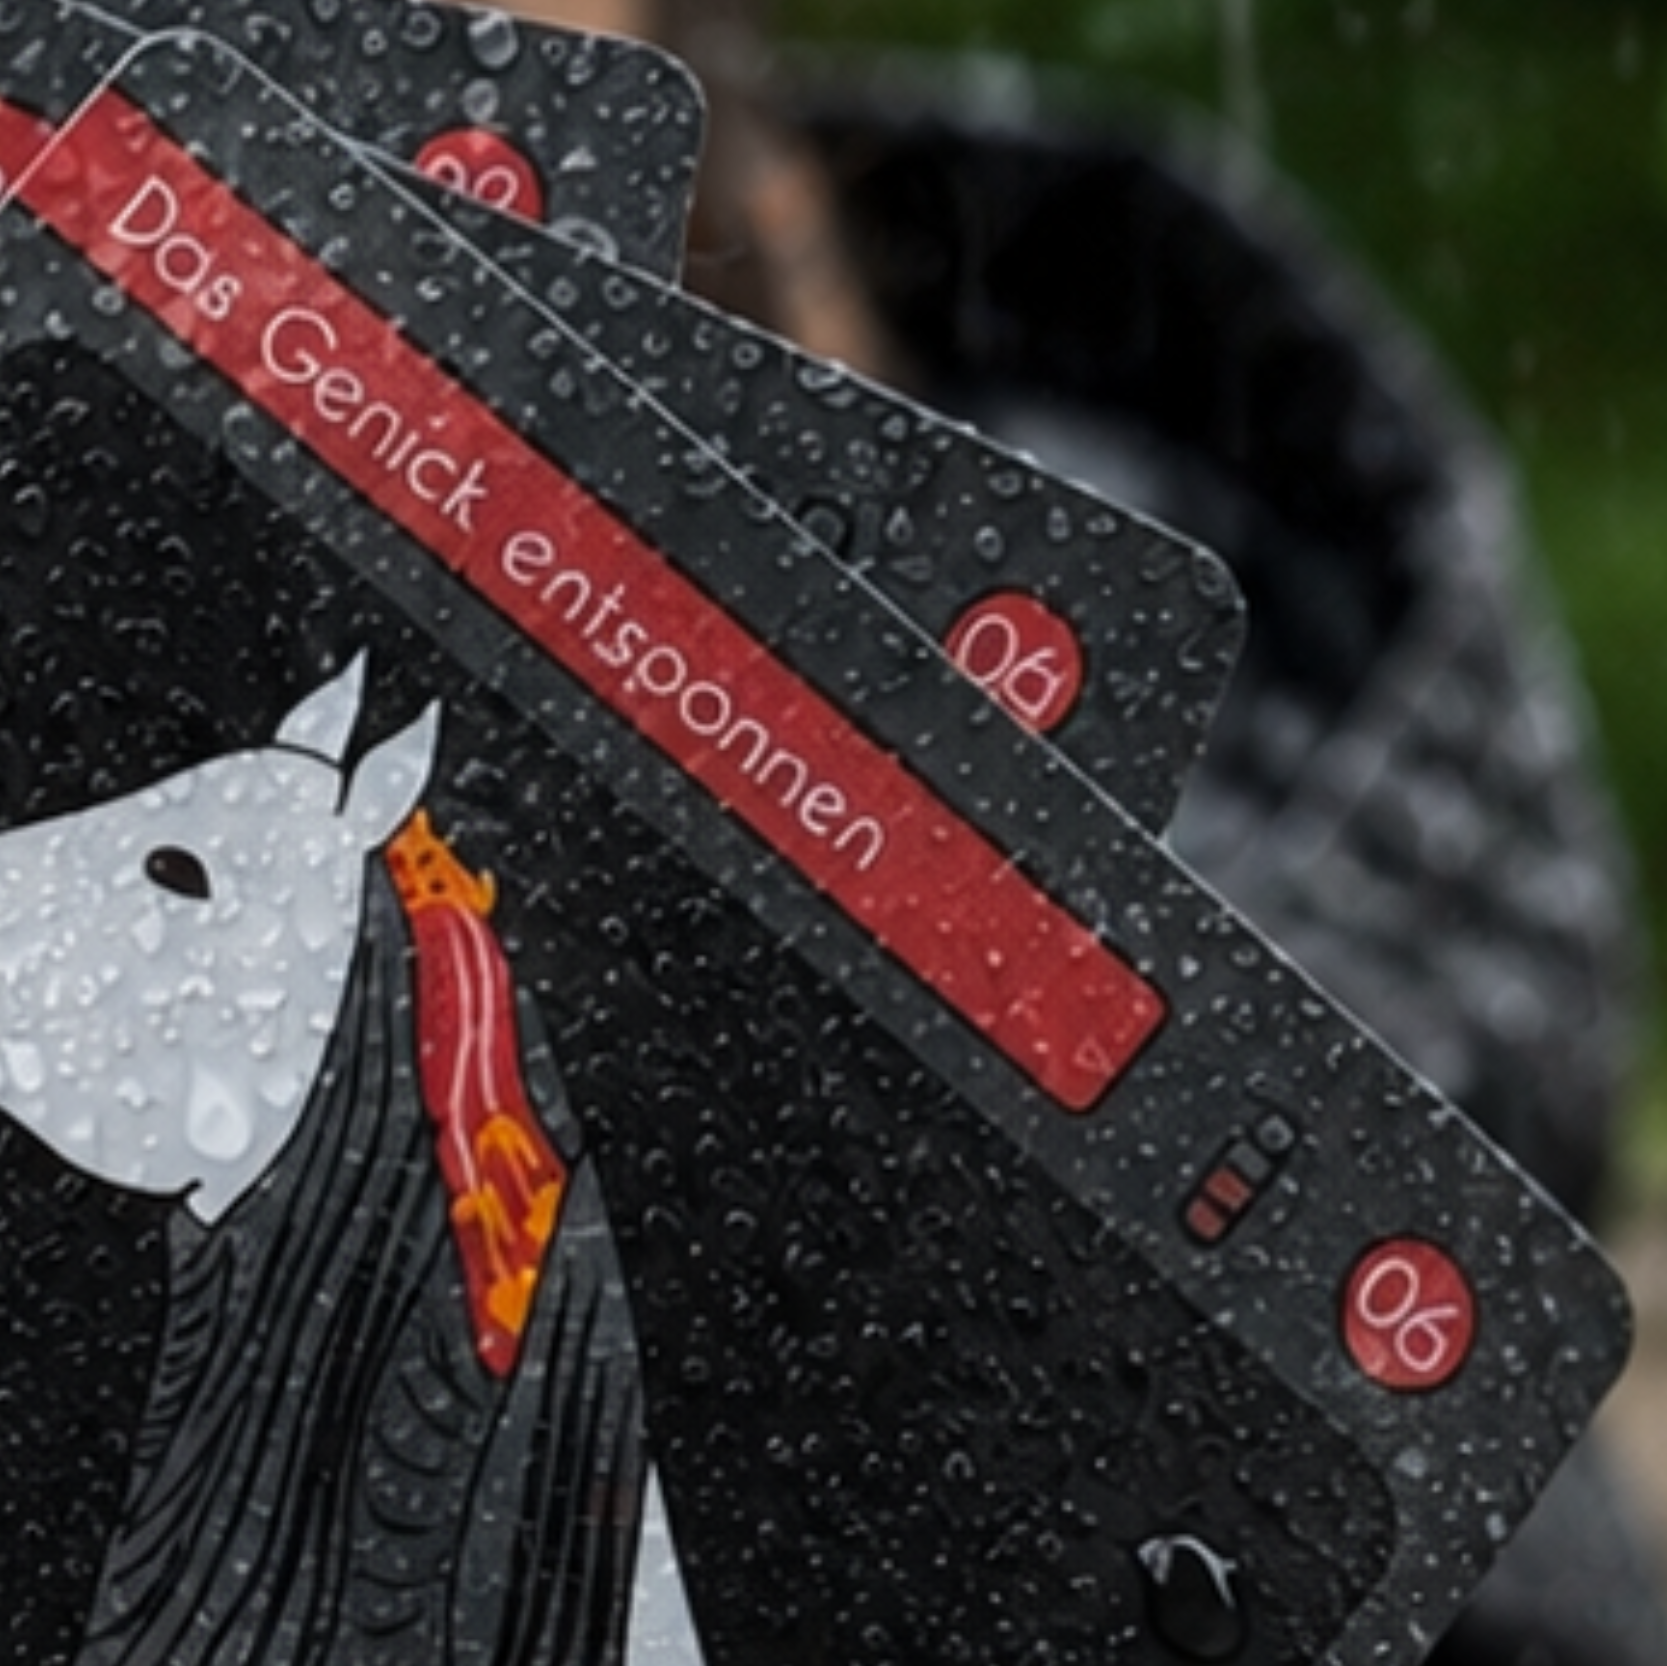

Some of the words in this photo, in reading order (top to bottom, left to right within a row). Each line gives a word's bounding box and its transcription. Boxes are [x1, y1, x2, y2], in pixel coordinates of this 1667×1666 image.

[108, 176, 243, 323] Das
[261, 309, 491, 534] Genick
[1356, 1257, 1460, 1373] 06
